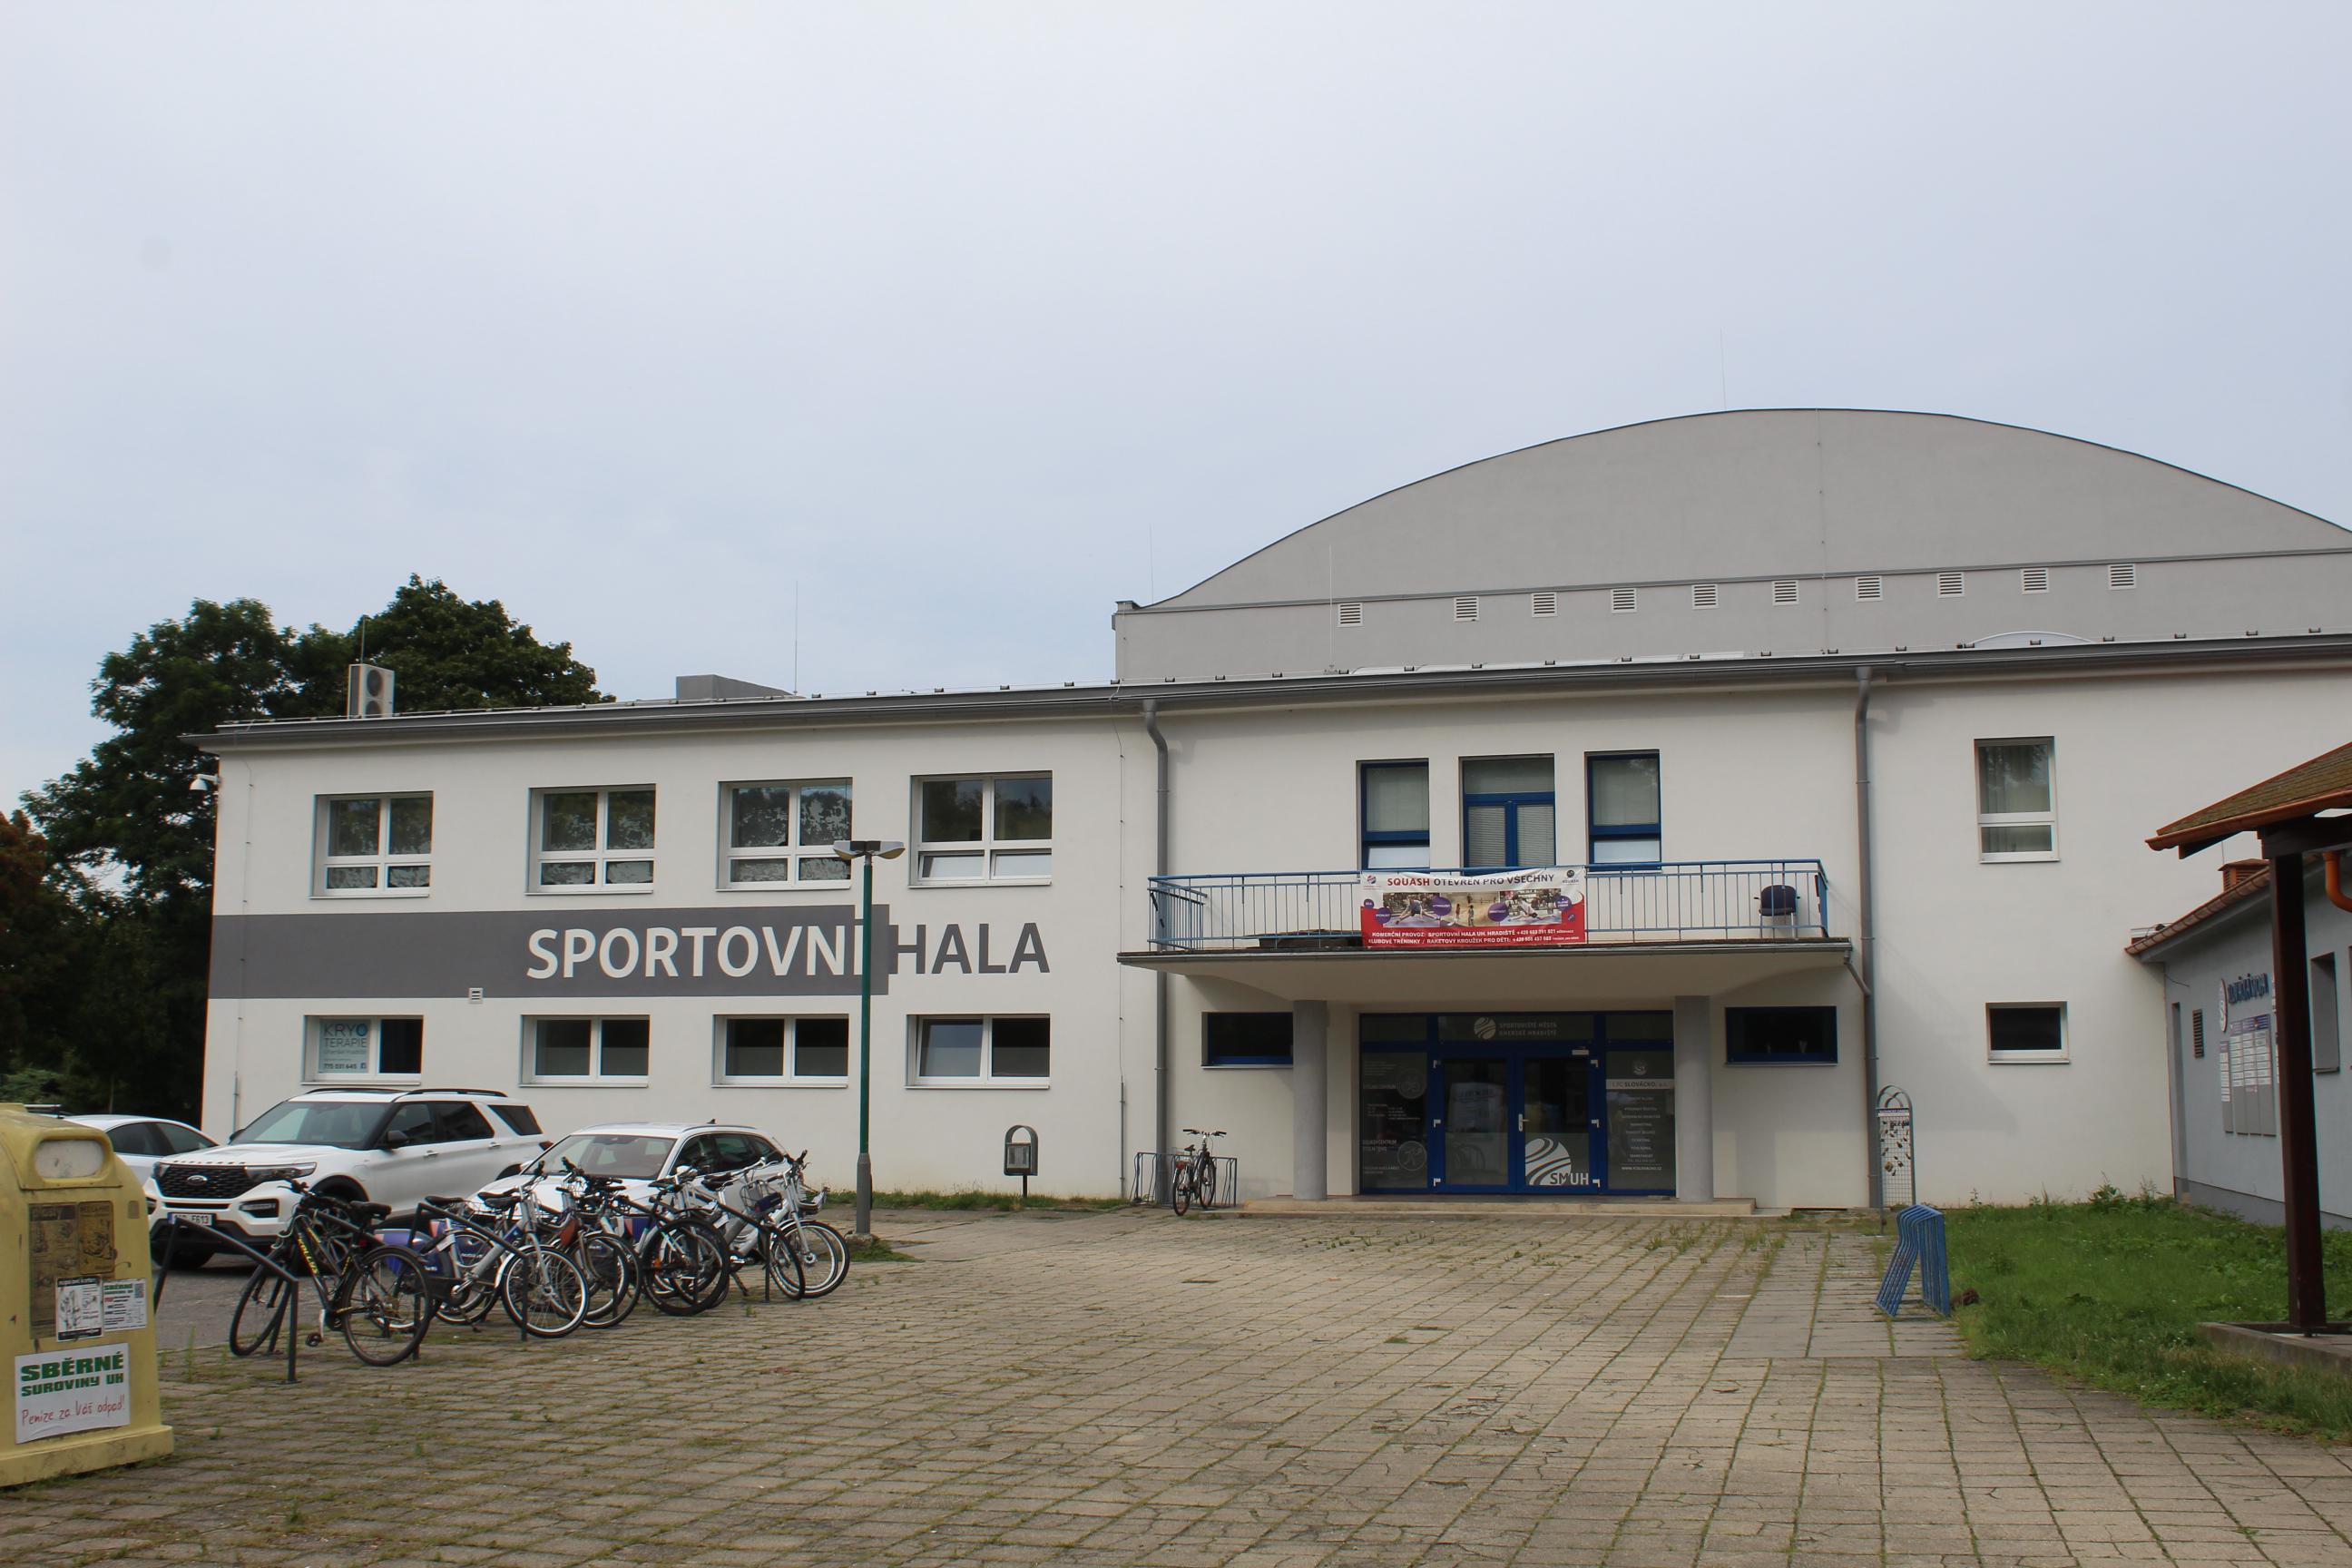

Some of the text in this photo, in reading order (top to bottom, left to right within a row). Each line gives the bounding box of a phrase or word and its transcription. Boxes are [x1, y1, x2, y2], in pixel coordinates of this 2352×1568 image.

[1387, 877, 1431, 887] SQUASH
[1483, 877, 1505, 886] PRO
[526, 907, 1051, 980] SPORTOVNÍ HALA
[323, 1023, 368, 1036] KRYO
[323, 1037, 368, 1048] TERAPIE
[1550, 1172, 1589, 1185] SMUH
[21, 1350, 124, 1382] SBĚRNÉ
[21, 1372, 124, 1397] SUROVINY UH
